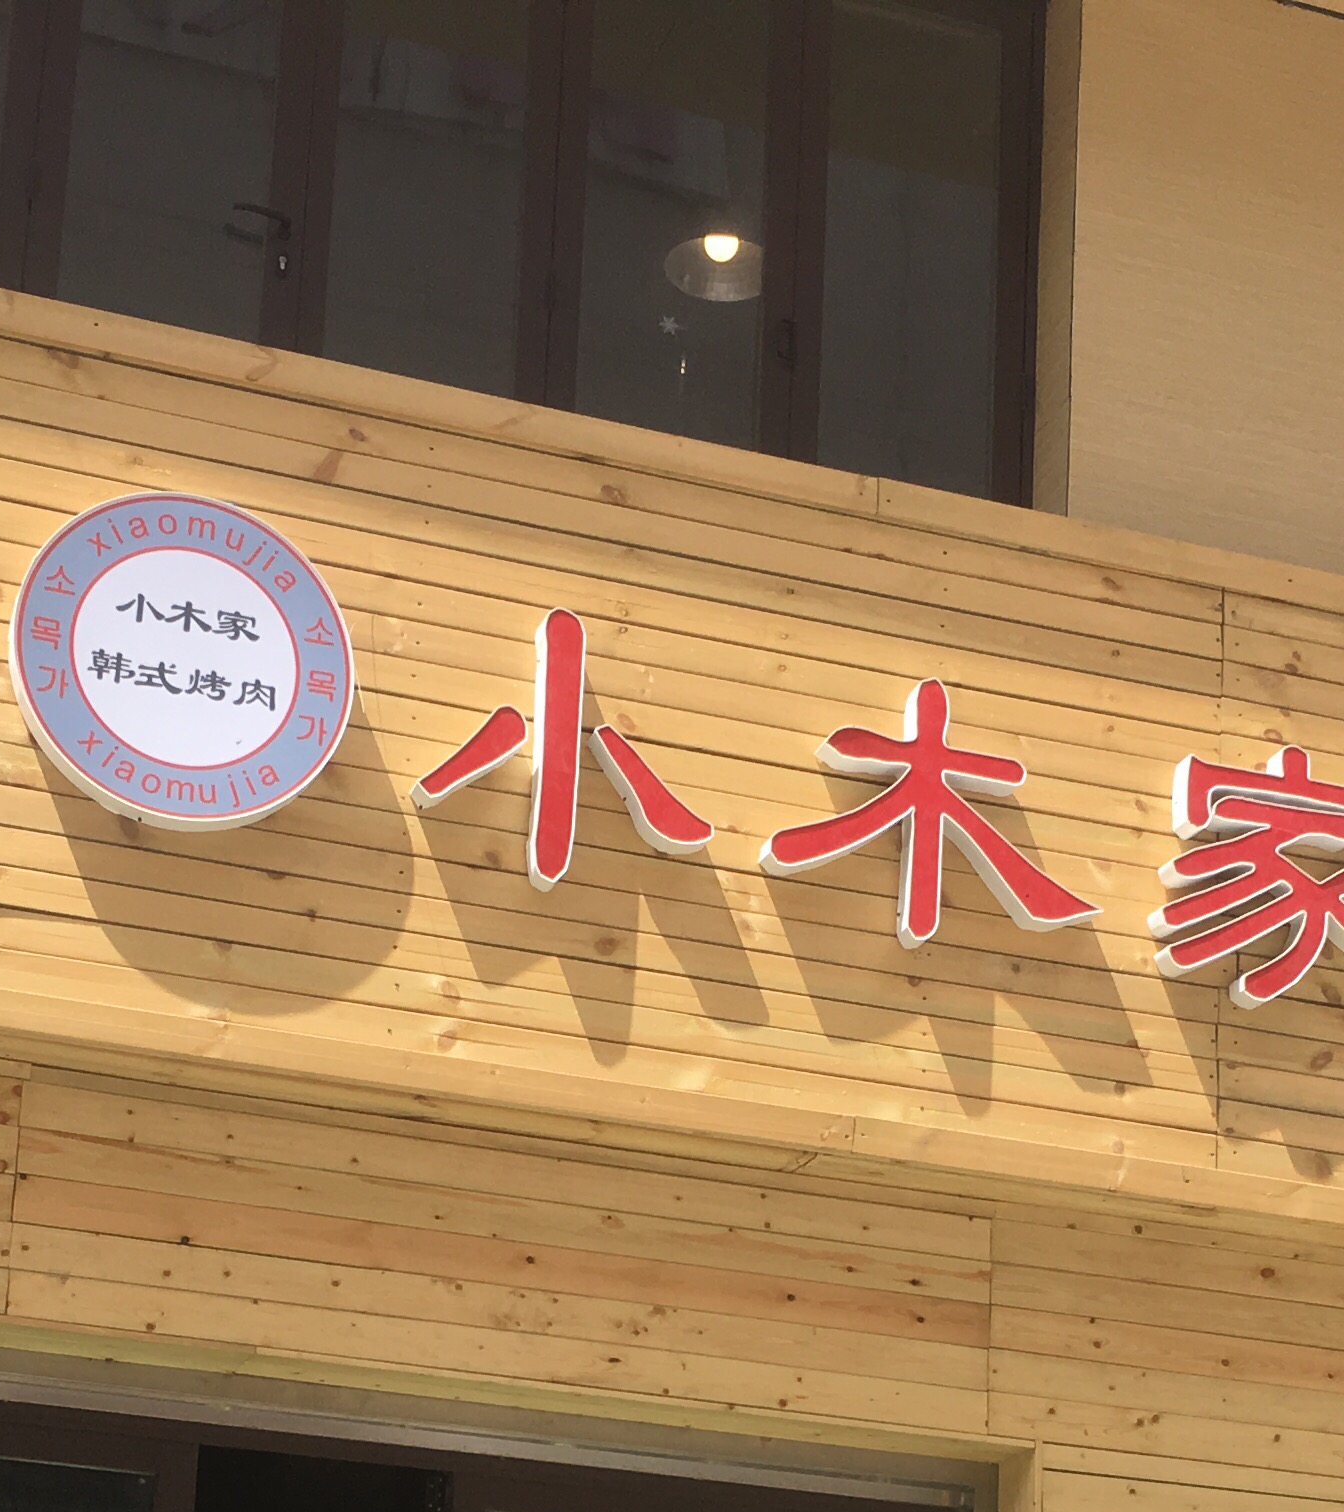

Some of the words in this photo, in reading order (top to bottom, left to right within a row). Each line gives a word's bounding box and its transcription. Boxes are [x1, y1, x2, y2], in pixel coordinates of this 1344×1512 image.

[86, 513, 296, 593] xiaomujia
[30, 564, 75, 699] 소목가
[115, 593, 260, 642] 小木家
[87, 648, 276, 711] 韩式烤肉
[296, 616, 338, 747] 소목가
[77, 729, 280, 807] xiaomujia
